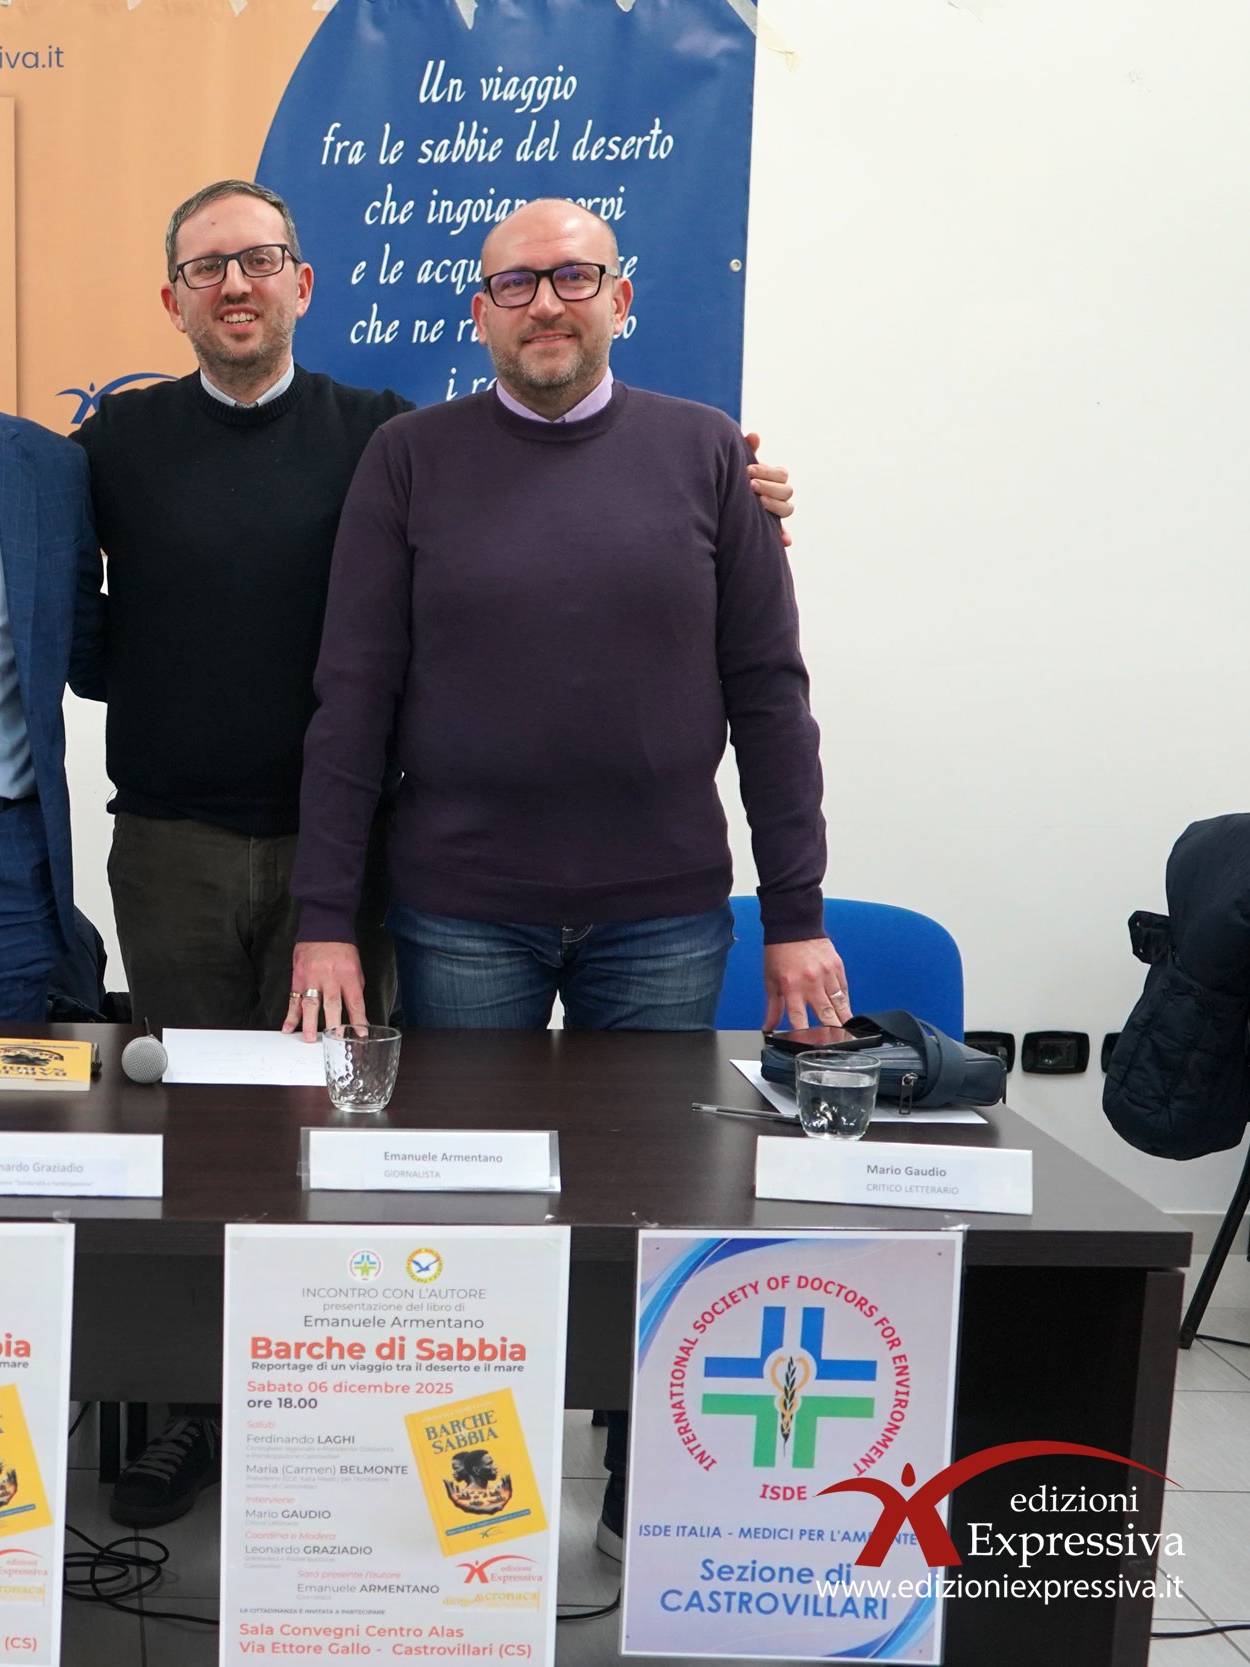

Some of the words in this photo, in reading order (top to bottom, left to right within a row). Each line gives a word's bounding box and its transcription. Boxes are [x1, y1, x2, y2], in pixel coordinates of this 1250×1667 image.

[419, 60, 466, 103] Un
[480, 65, 578, 113] viaggio
[321, 122, 366, 165] fra
[379, 122, 404, 165] le
[418, 120, 503, 164] sabbie
[515, 119, 560, 162] del
[572, 117, 674, 161] deserto
[364, 183, 413, 225] che
[351, 261, 367, 285] e
[379, 243, 404, 285] le
[417, 258, 482, 295] acqu
[350, 302, 400, 344] che
[412, 318, 445, 344] ne
[384, 1151, 438, 1162] Emanuele
[441, 1152, 503, 1163] Armentano
[32, 1162, 84, 1173] Graziadio
[384, 1170, 441, 1179] GIORNALISTA
[867, 1164, 901, 1176] Mario
[905, 1166, 947, 1177] Gaudio
[866, 1183, 902, 1193] CRITICO
[904, 1185, 959, 1195] LETTERARIO
[767, 1275, 791, 1291] OF
[302, 1288, 378, 1299] INCONTRO
[382, 1288, 414, 1299] CON
[419, 1288, 486, 1300] L'AUTORE
[797, 1275, 879, 1318] DOCTORS
[323, 1301, 403, 1313] presentazione
[407, 1301, 423, 1312] del
[427, 1301, 451, 1312] libro
[454, 1301, 465, 1312] di
[692, 1281, 760, 1334] SOCIETY
[303, 1315, 386, 1328] Emanuele
[391, 1315, 484, 1329] Armentano
[874, 1317, 902, 1351] FOR
[250, 1336, 366, 1360] Barche
[375, 1336, 405, 1360] di
[416, 1337, 526, 1361] Sabbia
[251, 1362, 313, 1373] Reportage
[316, 1362, 327, 1371] di
[350, 1362, 393, 1374] viaggio
[396, 1363, 412, 1371] tra
[415, 1362, 422, 1372] il
[425, 1362, 470, 1372] deserto
[484, 1363, 491, 1372] il
[247, 1380, 303, 1393] Sabato
[308, 1381, 328, 1393] 06
[333, 1381, 411, 1394] dicembre
[415, 1382, 454, 1394] 2025
[247, 1399, 273, 1409] ore
[277, 1397, 318, 1409] 18.00
[670, 1337, 718, 1472] INTERNATIONAL
[853, 1354, 911, 1477] ENVIRONMENT
[425, 1409, 498, 1441] BARCHE
[246, 1434, 314, 1444] Ferdinando
[317, 1435, 355, 1445] LAGHI
[431, 1426, 499, 1455] SABBIA
[246, 1464, 278, 1474] Maria
[282, 1464, 337, 1476] (Carmen)
[340, 1465, 409, 1475] BELMONTE
[759, 1484, 807, 1500] ISDE
[245, 1509, 278, 1519] Mario
[281, 1509, 331, 1519] GAUDIO
[639, 1524, 671, 1537] ISDE
[676, 1525, 722, 1538] ITALIA
[739, 1527, 793, 1540] MEDICI
[799, 1529, 824, 1541] PER
[830, 1530, 918, 1545] L'AMNTE
[245, 1544, 301, 1554] Leonardo
[303, 1545, 373, 1555] GRAZIADIO
[490, 1574, 543, 1584] Expressiva
[700, 1558, 814, 1585] Sezione
[825, 1562, 853, 1586] di
[297, 1583, 357, 1593] Emanuele
[359, 1584, 440, 1594] ARMENTANO
[660, 1588, 887, 1620] CASTROVILLARI
[239, 1623, 274, 1637] Sala
[279, 1624, 360, 1639] Convegni
[365, 1625, 424, 1638] Centro
[429, 1625, 464, 1638] Alas
[239, 1641, 265, 1655] Via
[271, 1642, 323, 1655] Ettore
[328, 1642, 371, 1655] Gallo
[391, 1642, 493, 1657] Castrovillari
[498, 1643, 532, 1658] (CS)
